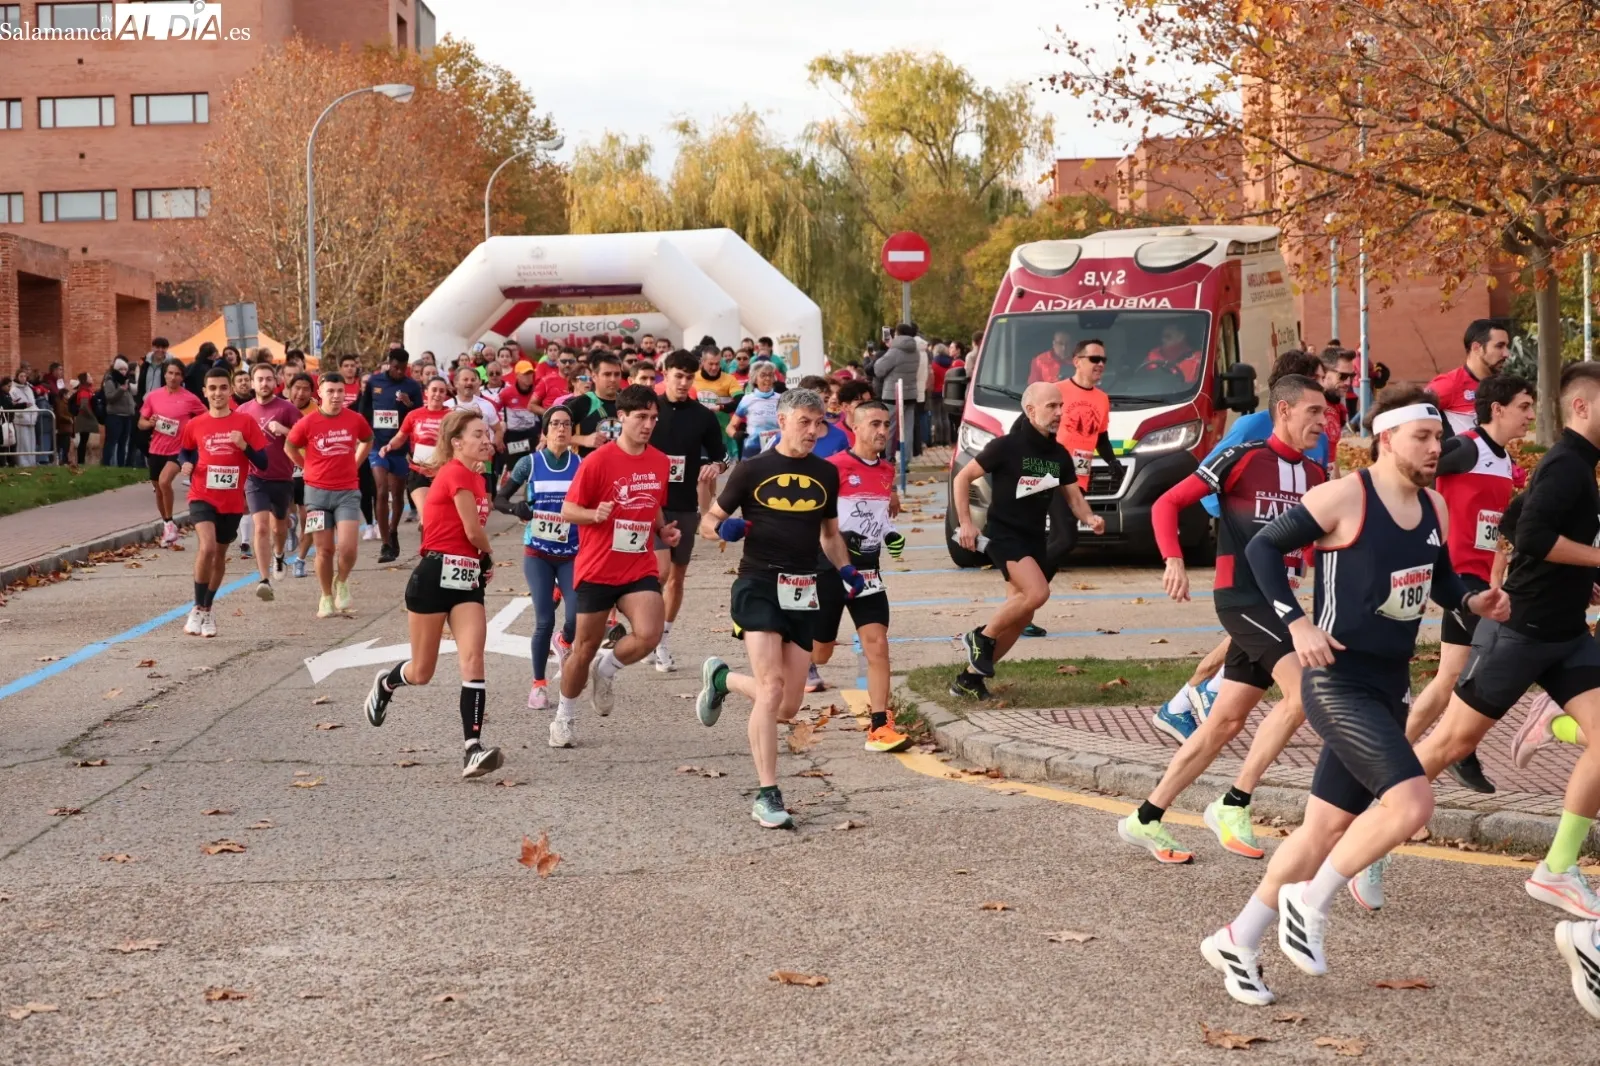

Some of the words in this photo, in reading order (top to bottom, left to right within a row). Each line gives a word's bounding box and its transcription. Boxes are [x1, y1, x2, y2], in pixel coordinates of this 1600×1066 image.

[161, 422, 171, 431] 59
[379, 416, 393, 424] 951
[214, 474, 233, 484] 143
[538, 521, 562, 536] 314
[630, 532, 638, 545] 2
[451, 568, 475, 582] 285
[793, 587, 803, 602] 5
[1399, 586, 1423, 609] 180
